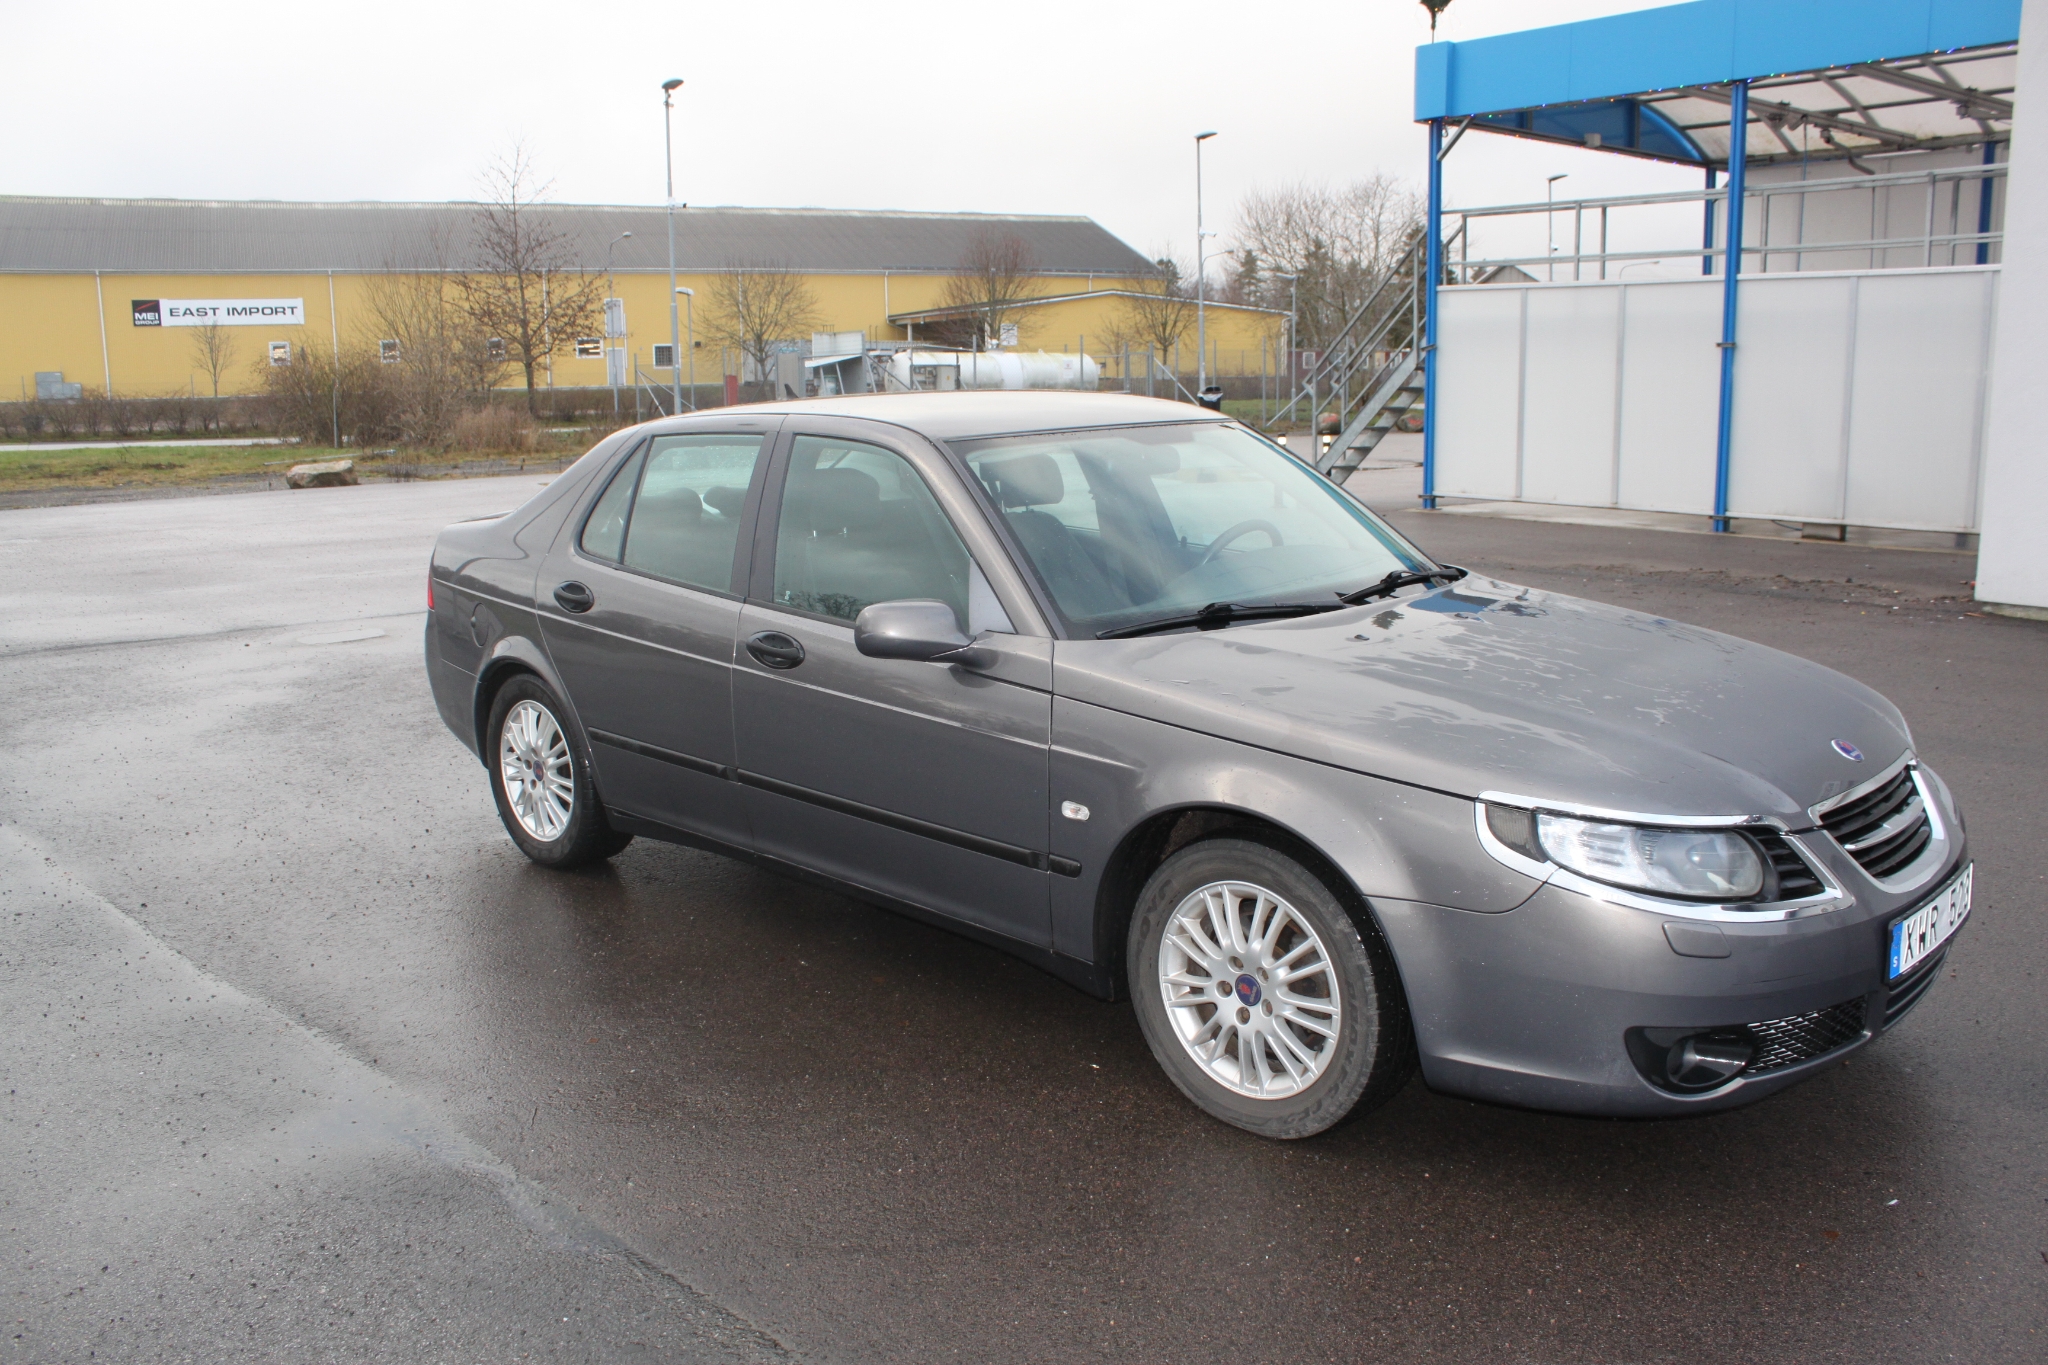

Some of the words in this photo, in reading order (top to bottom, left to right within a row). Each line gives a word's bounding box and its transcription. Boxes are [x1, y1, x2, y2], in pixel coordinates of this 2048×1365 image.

[134, 312, 159, 320] MEI
[169, 307, 220, 317] EAST
[227, 306, 298, 316] IMPORT
[1902, 904, 1939, 965] XWR
[1947, 872, 1969, 926] 523
[1892, 956, 1898, 967] S
